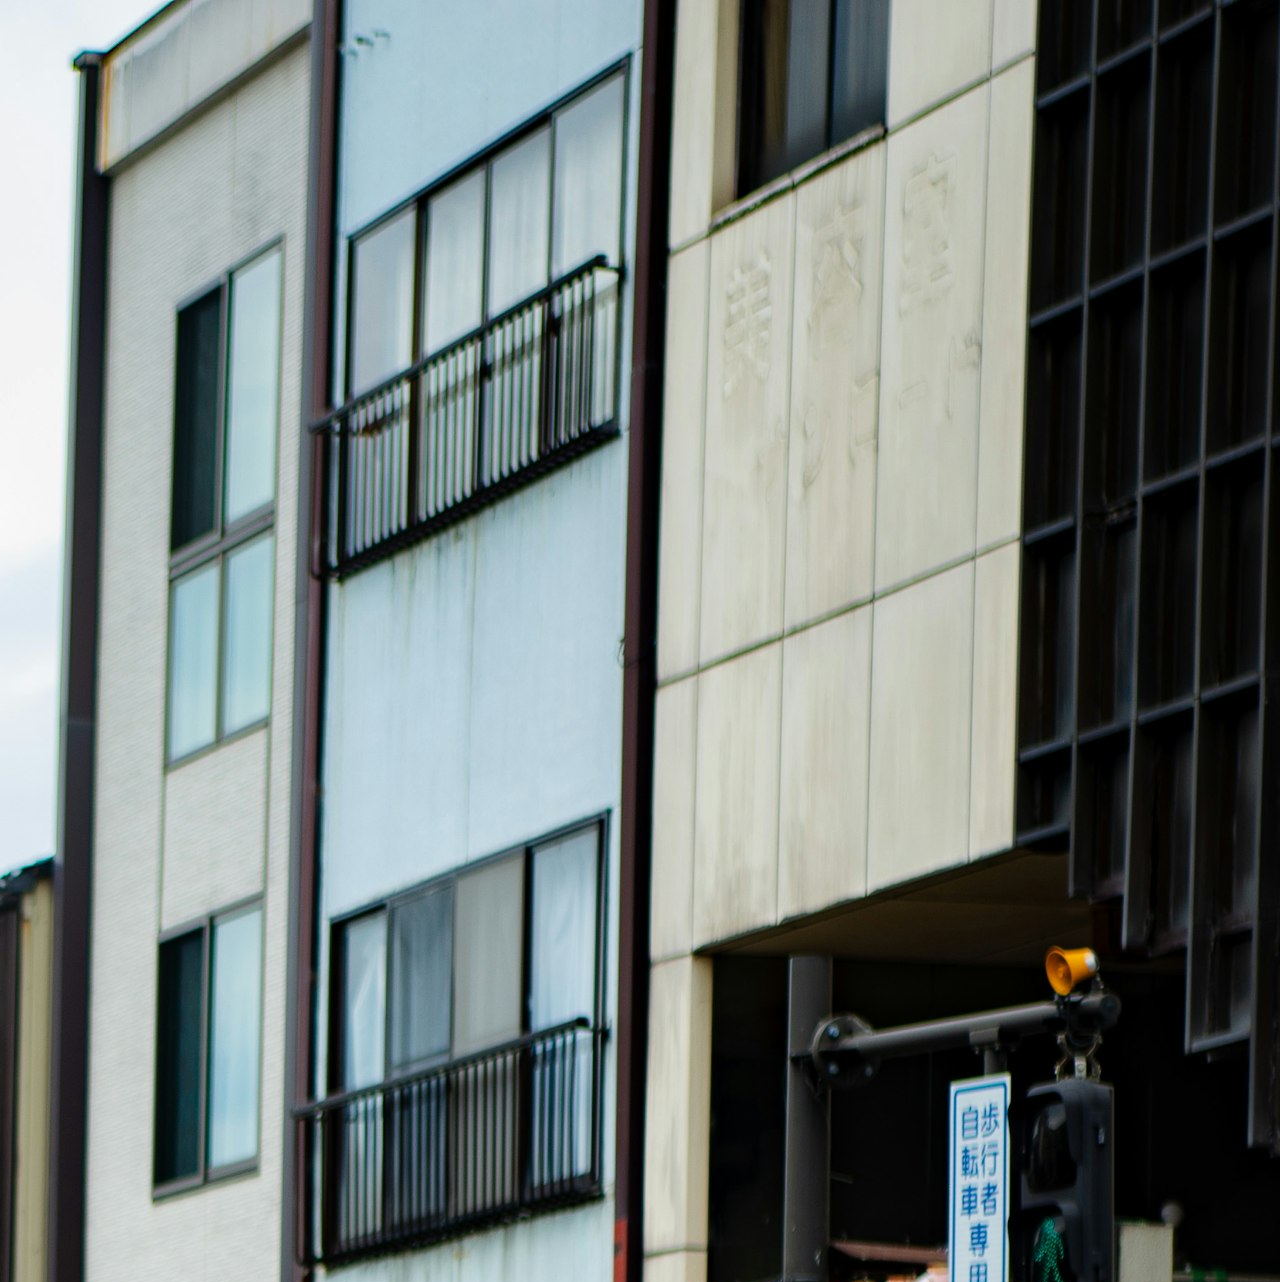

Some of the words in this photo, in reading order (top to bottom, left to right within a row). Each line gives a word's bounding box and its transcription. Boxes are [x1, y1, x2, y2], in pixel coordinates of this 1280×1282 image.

[960, 1104, 980, 1220] 自転車
[980, 1102, 1000, 1217] 歩行者
